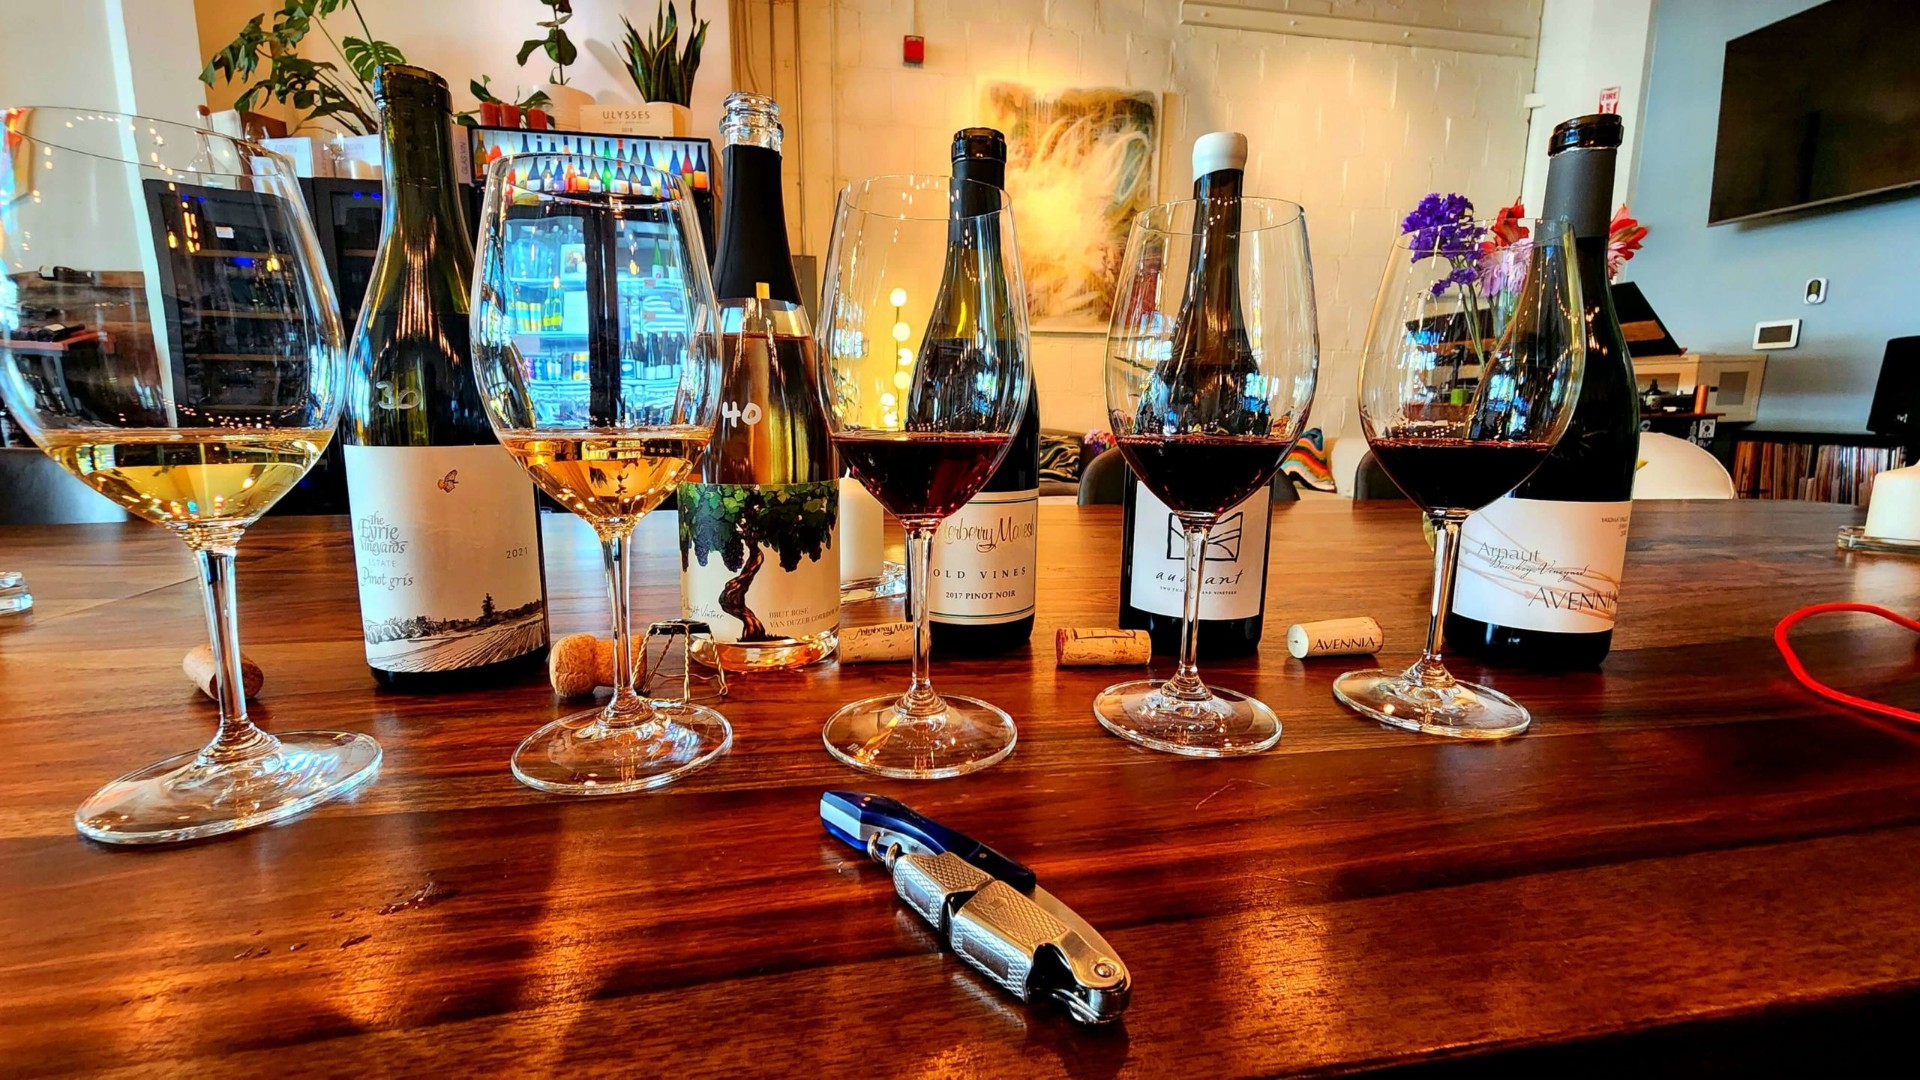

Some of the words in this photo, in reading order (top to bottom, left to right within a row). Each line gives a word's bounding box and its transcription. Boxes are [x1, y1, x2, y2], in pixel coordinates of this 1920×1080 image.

[602, 110, 651, 120] ULYSSES
[722, 400, 762, 428] 40
[366, 510, 385, 525] The
[358, 518, 400, 543] Eyrie
[359, 538, 409, 556] Vineyards
[505, 546, 528, 559] 2021
[1477, 541, 1541, 562] Arnaut
[368, 558, 397, 568] ESTATE
[360, 566, 387, 587] Pinot
[387, 573, 415, 591] gris
[933, 568, 966, 579] OLD
[980, 566, 1026, 579] VINES
[1155, 568, 1244, 585] auant
[965, 592, 993, 600] PINOT
[995, 589, 1016, 599] NOIR
[769, 610, 790, 619] BRUT
[769, 620, 786, 629] VAN
[786, 616, 810, 627] DUZER
[1313, 636, 1375, 650] AVENNIA
